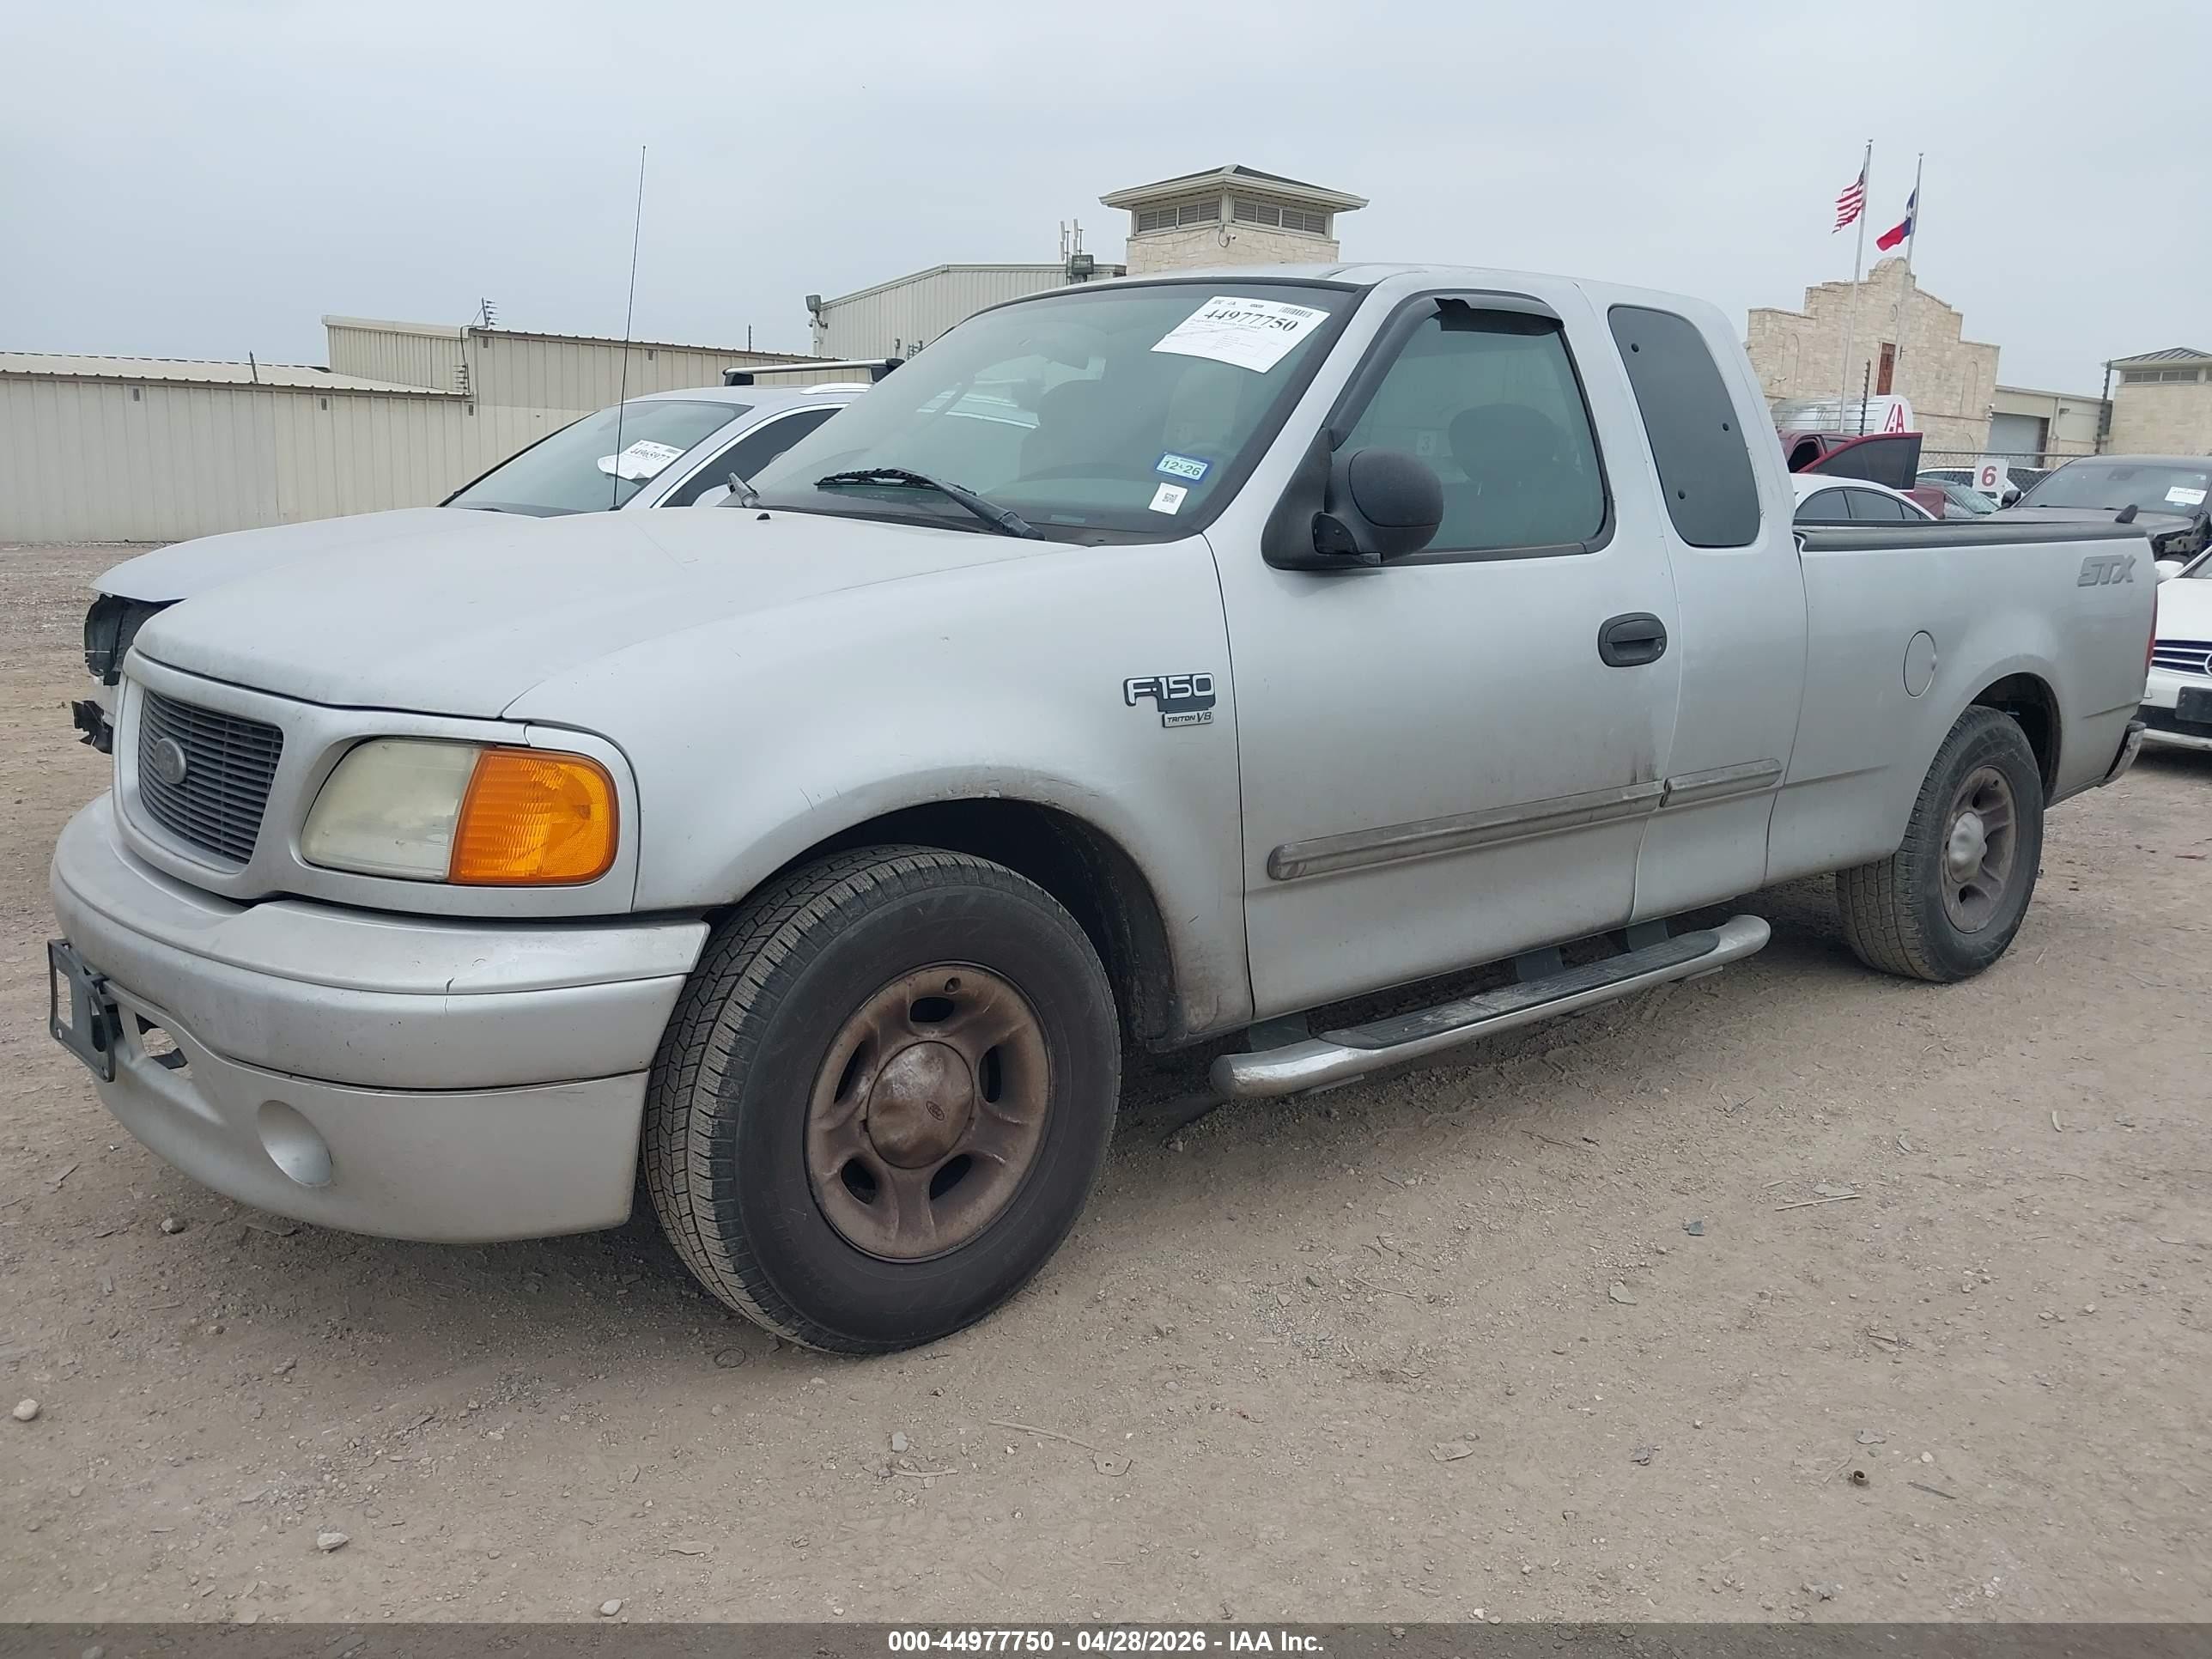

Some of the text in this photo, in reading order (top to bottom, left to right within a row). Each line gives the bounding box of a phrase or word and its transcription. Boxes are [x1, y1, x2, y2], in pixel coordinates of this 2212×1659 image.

[1204, 308, 1298, 332] 44977750
[1981, 465, 1997, 487] 6
[2077, 555, 2137, 587] STX
[1167, 711, 1212, 724] TRITON V8
